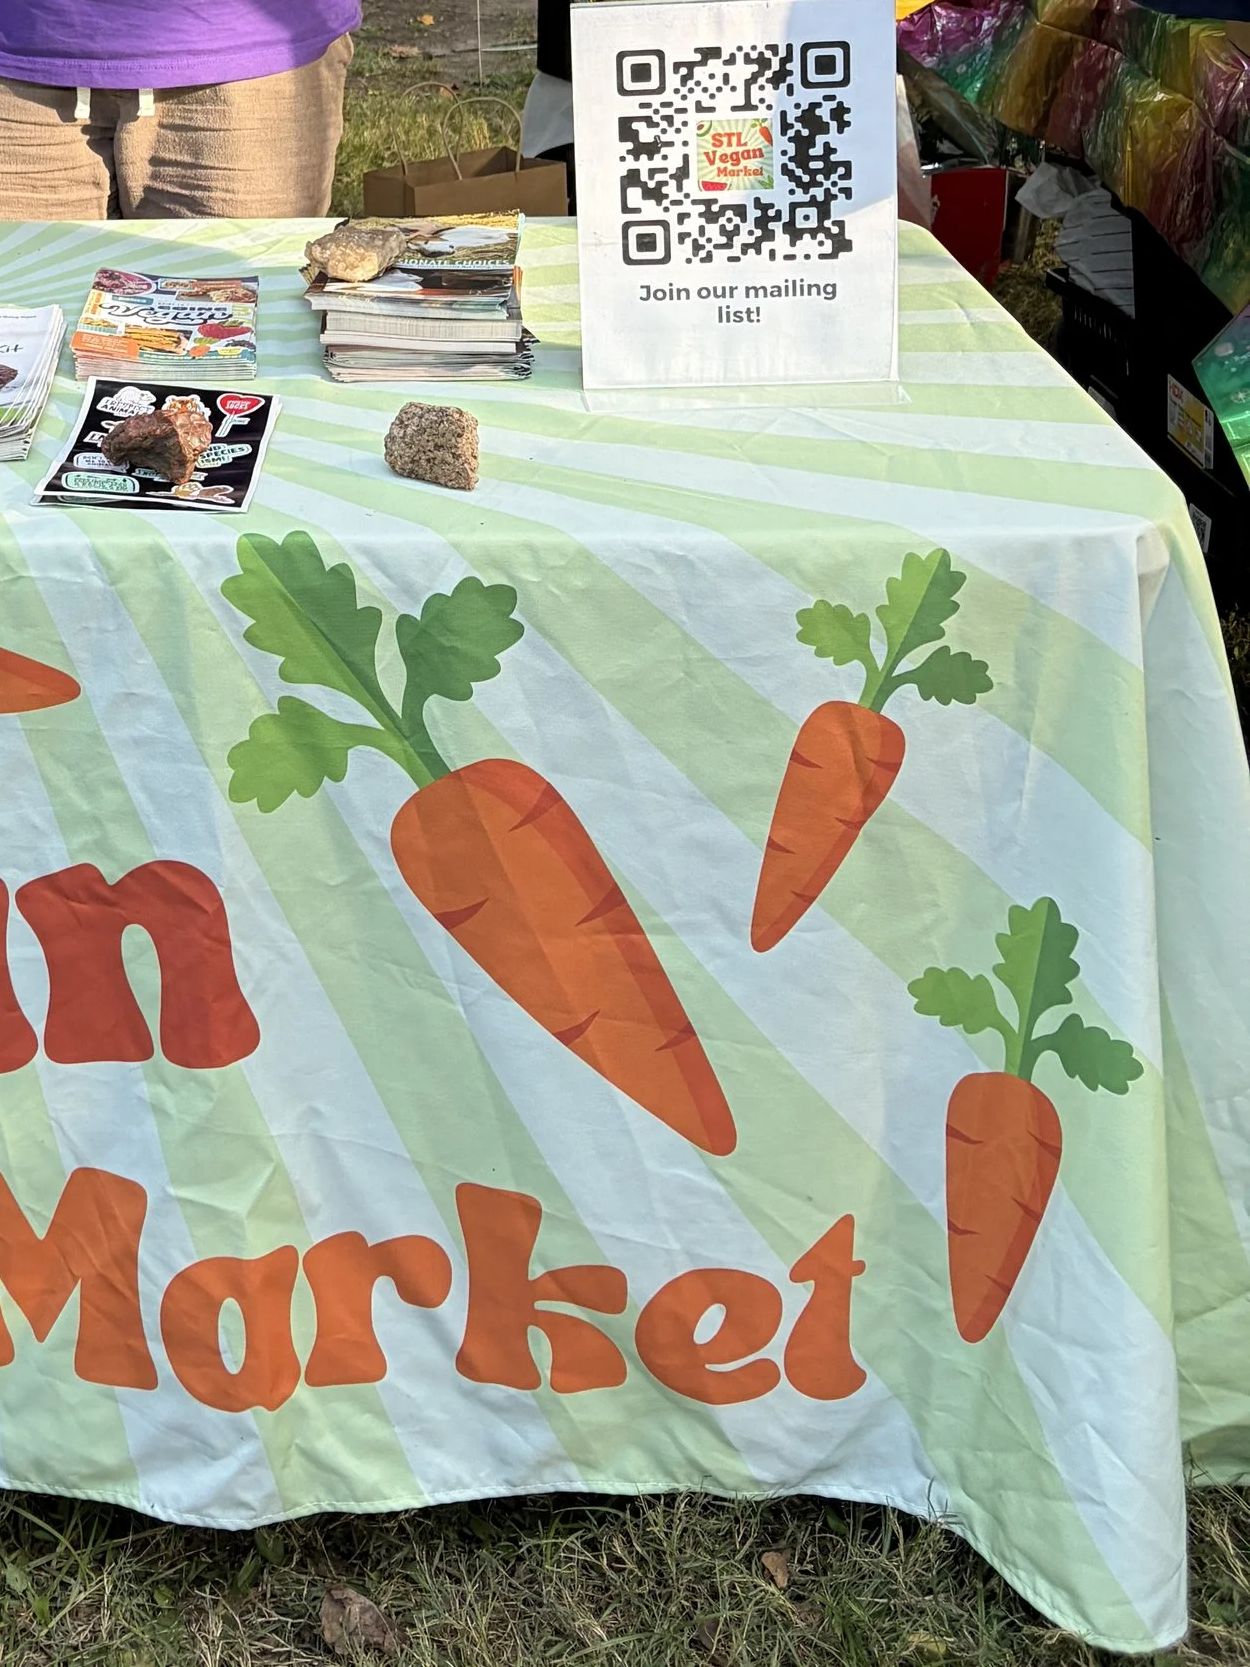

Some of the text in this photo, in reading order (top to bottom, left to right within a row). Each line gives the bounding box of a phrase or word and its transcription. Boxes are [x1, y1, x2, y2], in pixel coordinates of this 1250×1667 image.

[711, 130, 748, 149] STL
[703, 146, 765, 169] Vegan
[716, 165, 764, 179] Market
[638, 278, 837, 304] Join our mailing
[99, 301, 234, 326] Vegan
[716, 304, 762, 324] list!
